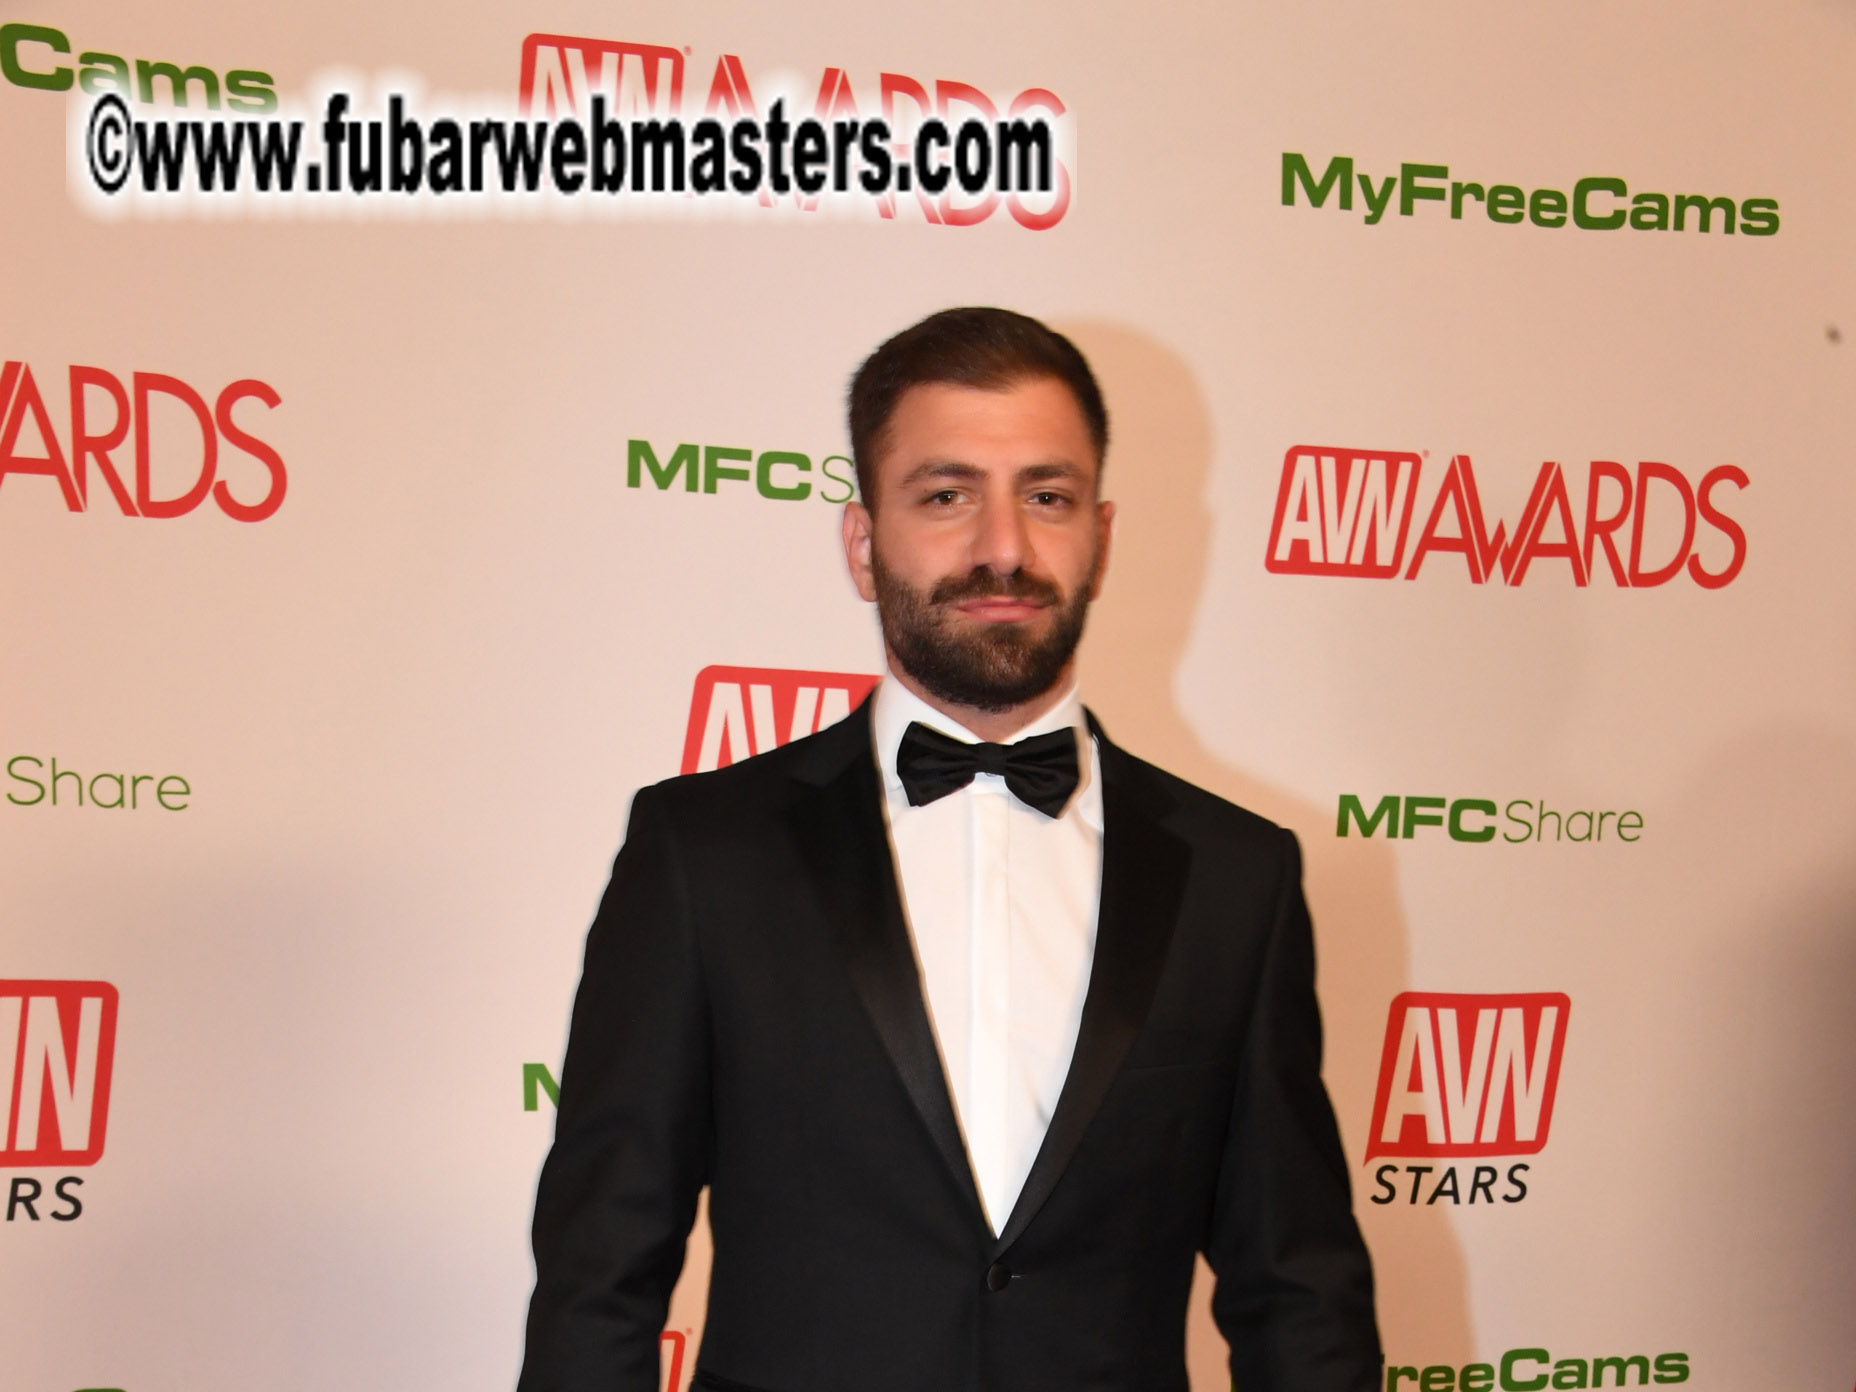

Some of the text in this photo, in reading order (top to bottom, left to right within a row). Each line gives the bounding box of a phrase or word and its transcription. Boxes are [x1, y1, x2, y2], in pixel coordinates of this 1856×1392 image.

[1281, 152, 1780, 236] MyFreeCams
[0, 360, 288, 523] ARDS
[1274, 454, 1751, 590] AVN AWARDS
[1335, 793, 1645, 844] MFCShare
[1380, 1006, 1560, 1144] AVN
[1370, 1163, 1531, 1206] STARS
